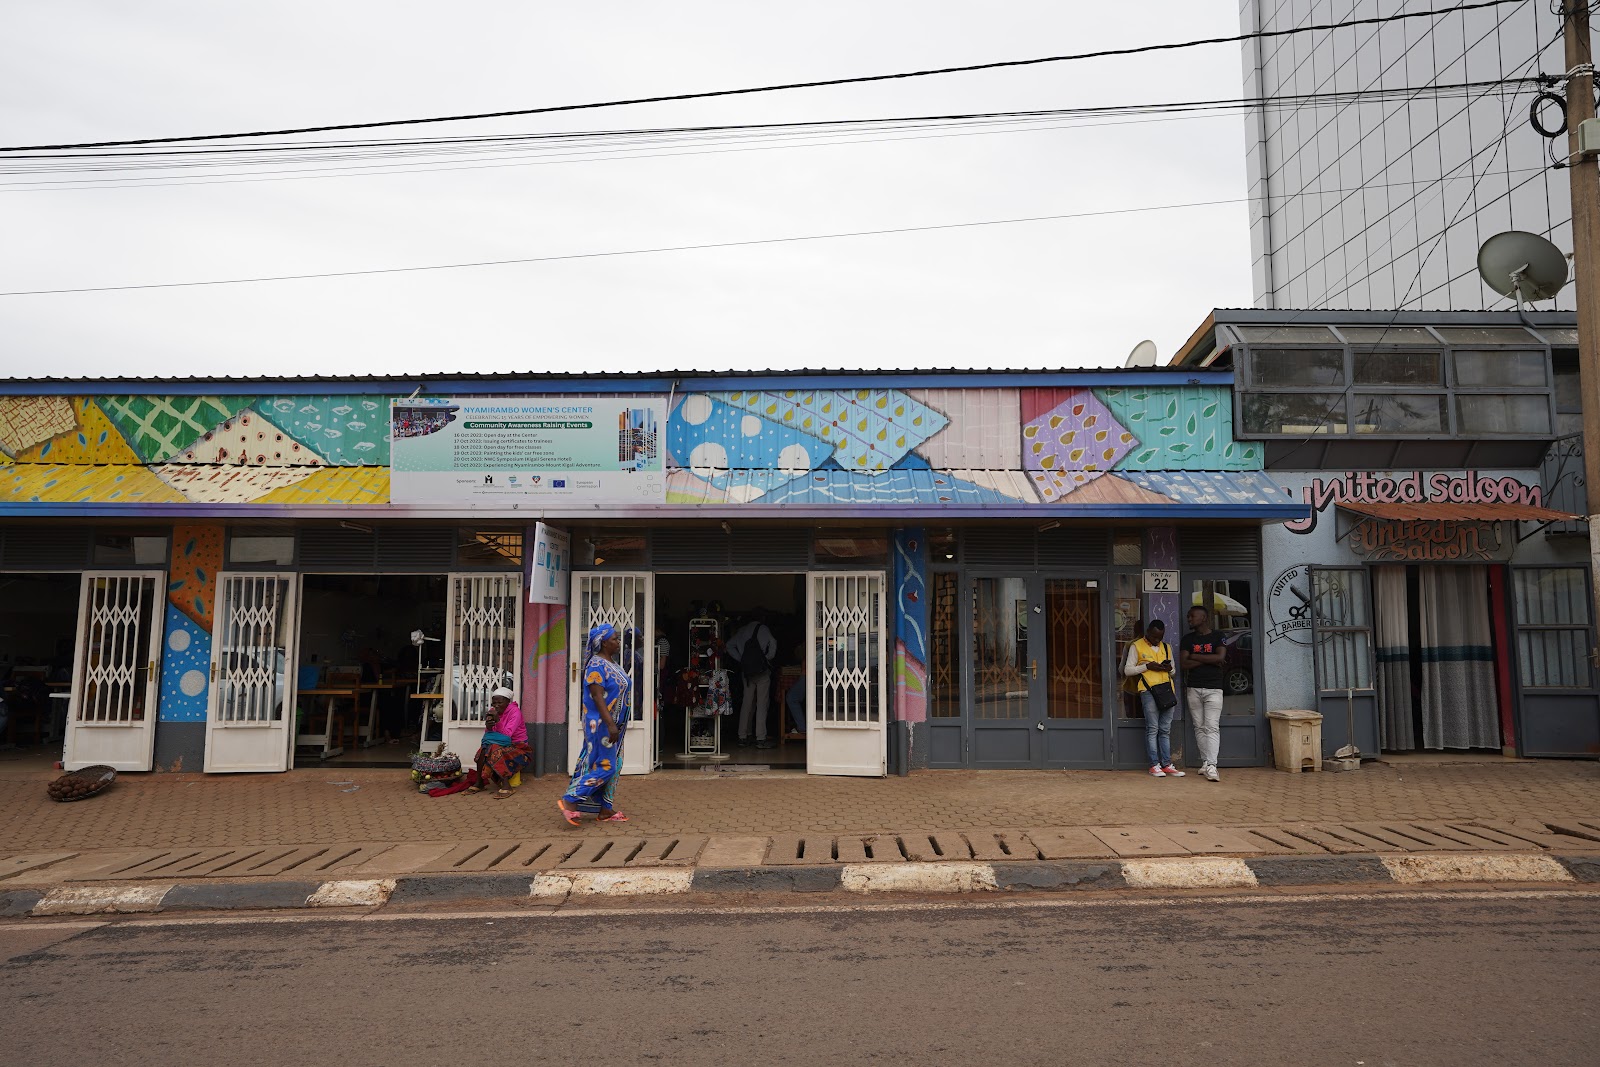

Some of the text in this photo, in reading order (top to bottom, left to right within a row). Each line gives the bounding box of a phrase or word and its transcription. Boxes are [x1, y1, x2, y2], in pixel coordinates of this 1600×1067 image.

[1154, 578, 1168, 590] 22
[1273, 570, 1298, 597] UNITED
[1282, 620, 1311, 632] BARBER
